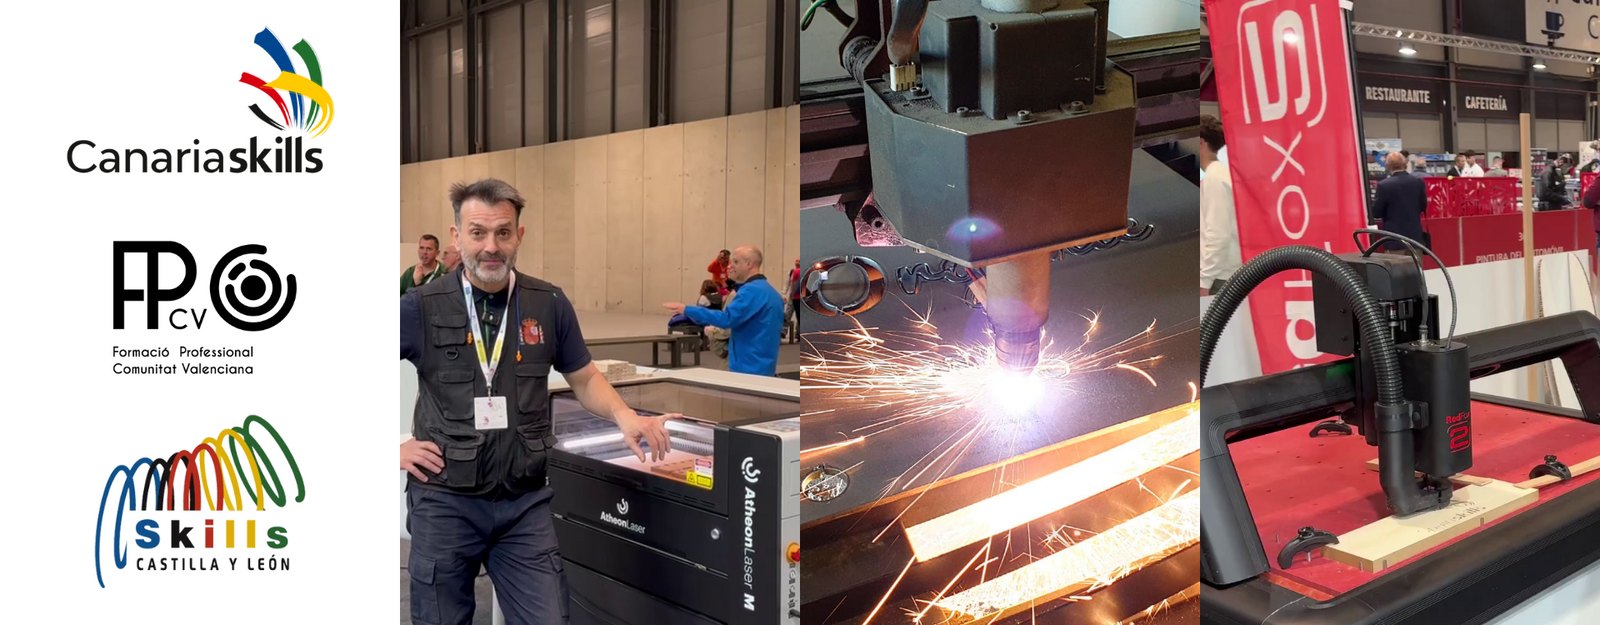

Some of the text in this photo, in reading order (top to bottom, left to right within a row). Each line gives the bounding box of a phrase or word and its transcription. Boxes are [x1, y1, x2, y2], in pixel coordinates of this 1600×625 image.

[1365, 86, 1431, 104] RESTAURANTE
[1465, 95, 1508, 111] CAFETERÍA
[67, 135, 323, 173] Canariaskills
[1476, 252, 1509, 264] PINTURA
[113, 241, 197, 329] FP
[169, 308, 207, 330] CV
[112, 346, 254, 358] Formació Professional
[112, 362, 254, 375] Comunitat Valenciana
[1446, 412, 1470, 424] RedFo
[600, 511, 646, 534] AtheonLaser
[743, 486, 756, 611] AtheonLaser M
[136, 554, 290, 571] CASTILLA Y LEÓN
